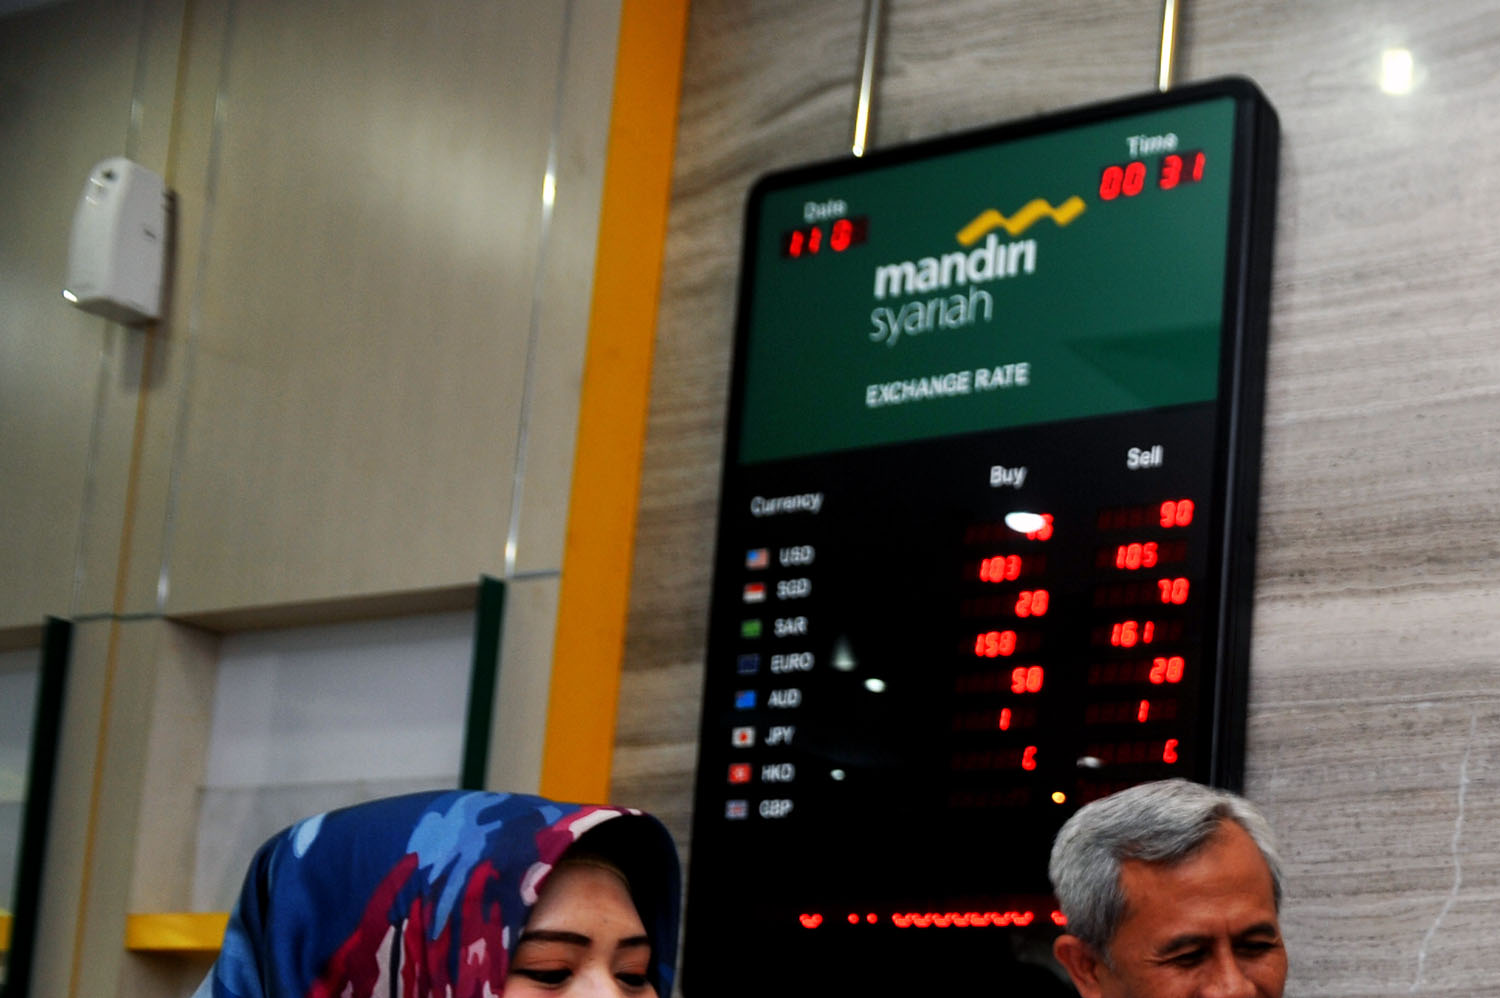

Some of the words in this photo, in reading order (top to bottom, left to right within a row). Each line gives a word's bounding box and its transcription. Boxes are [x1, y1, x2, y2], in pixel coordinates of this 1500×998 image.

[1126, 131, 1178, 157] Time
[803, 199, 847, 223] Date
[873, 234, 1038, 299] mandiri
[868, 285, 994, 346] syariah
[865, 371, 972, 407] EXCHANGE
[974, 361, 1031, 392] RATE
[1126, 445, 1164, 470] Sell
[990, 465, 1027, 489] Buy
[750, 492, 824, 518] Currency
[1160, 499, 1195, 528] 90
[779, 545, 816, 566] USD
[1116, 542, 1158, 571] 105
[776, 579, 811, 600] SGD
[774, 616, 808, 637] SAR
[770, 652, 815, 673] EURO
[768, 689, 801, 709] AUD
[764, 725, 794, 746] JPY
[761, 763, 795, 784] HKD
[759, 799, 793, 818] GBP
